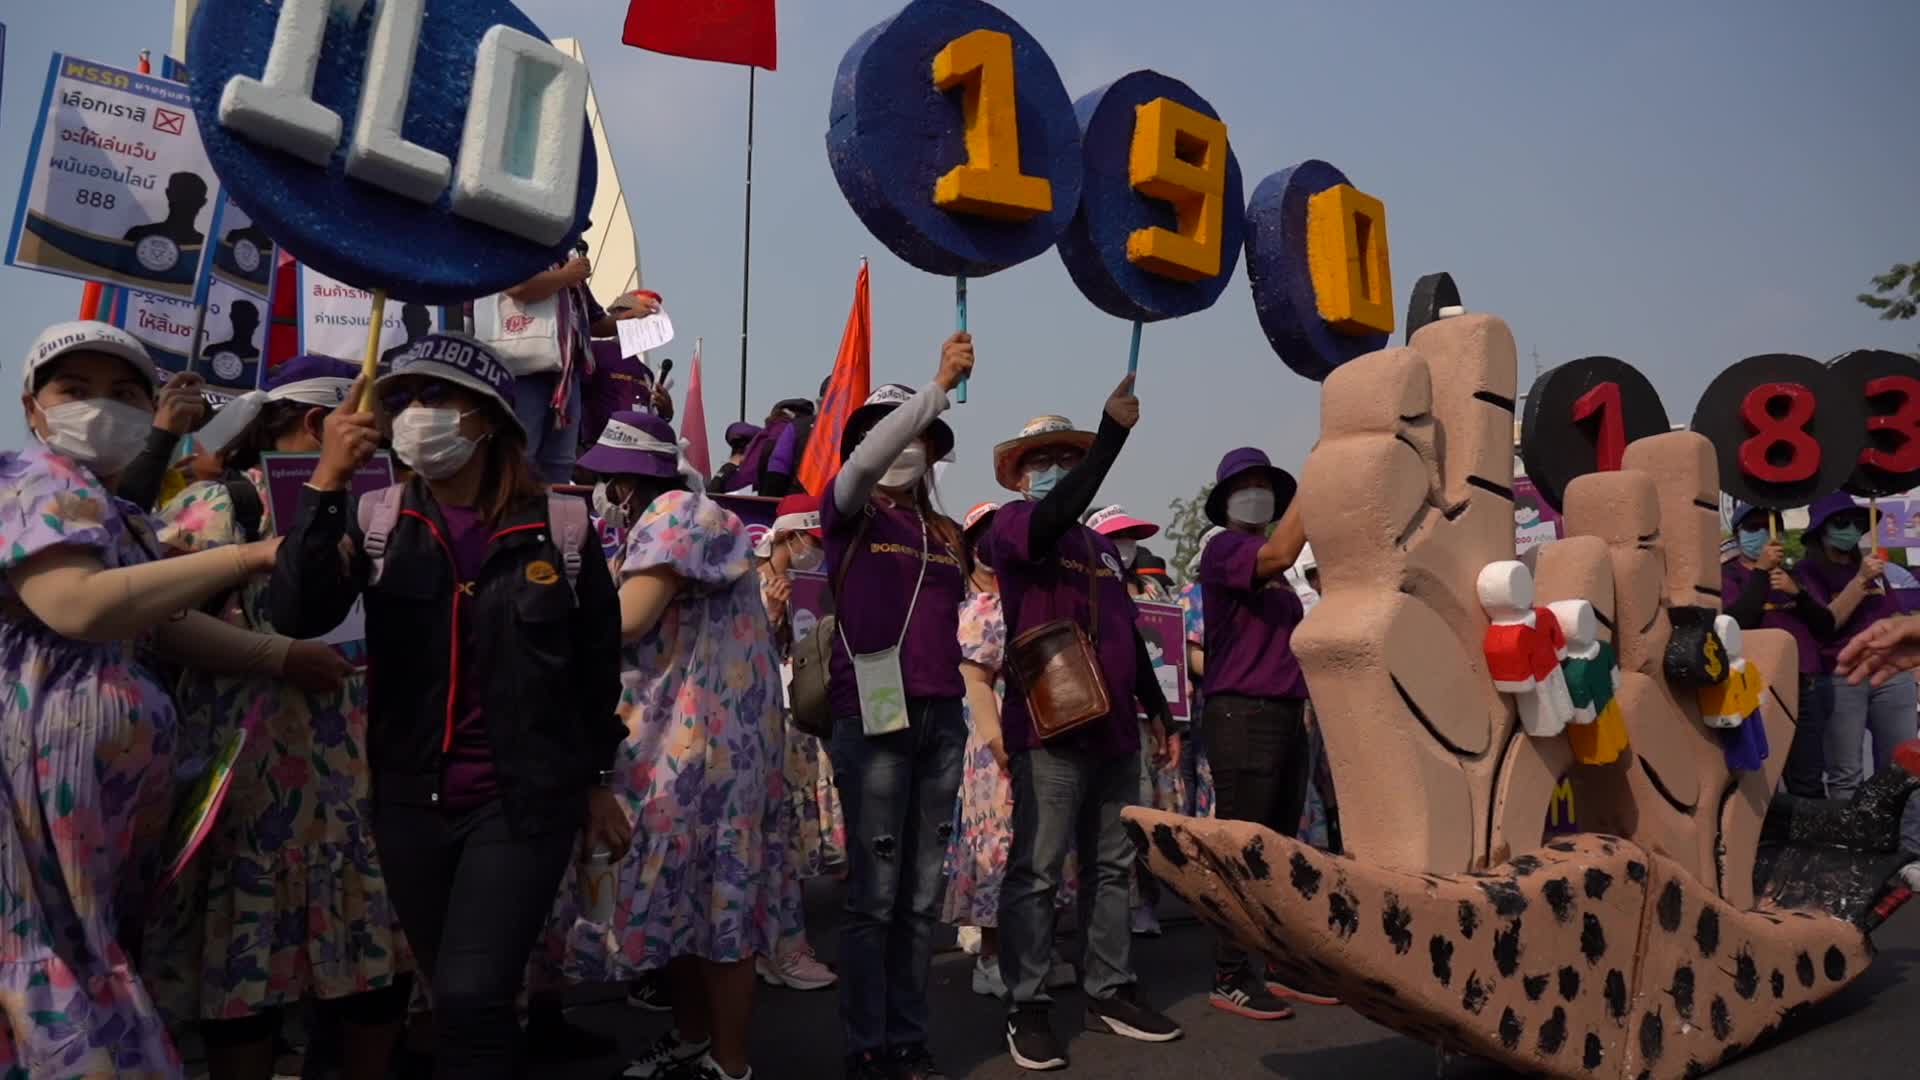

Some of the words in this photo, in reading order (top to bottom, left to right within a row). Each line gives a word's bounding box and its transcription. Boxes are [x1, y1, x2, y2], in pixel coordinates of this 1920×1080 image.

[66, 62, 130, 89] พรรค
[62, 89, 147, 123] เลือกเราสิ
[61, 126, 157, 161] จะให้เล่นเว็บ
[49, 155, 158, 190] พนันออนไลน์
[75, 188, 116, 210] 888
[313, 284, 373, 299] สินค้าราค
[434, 340, 474, 367] 180
